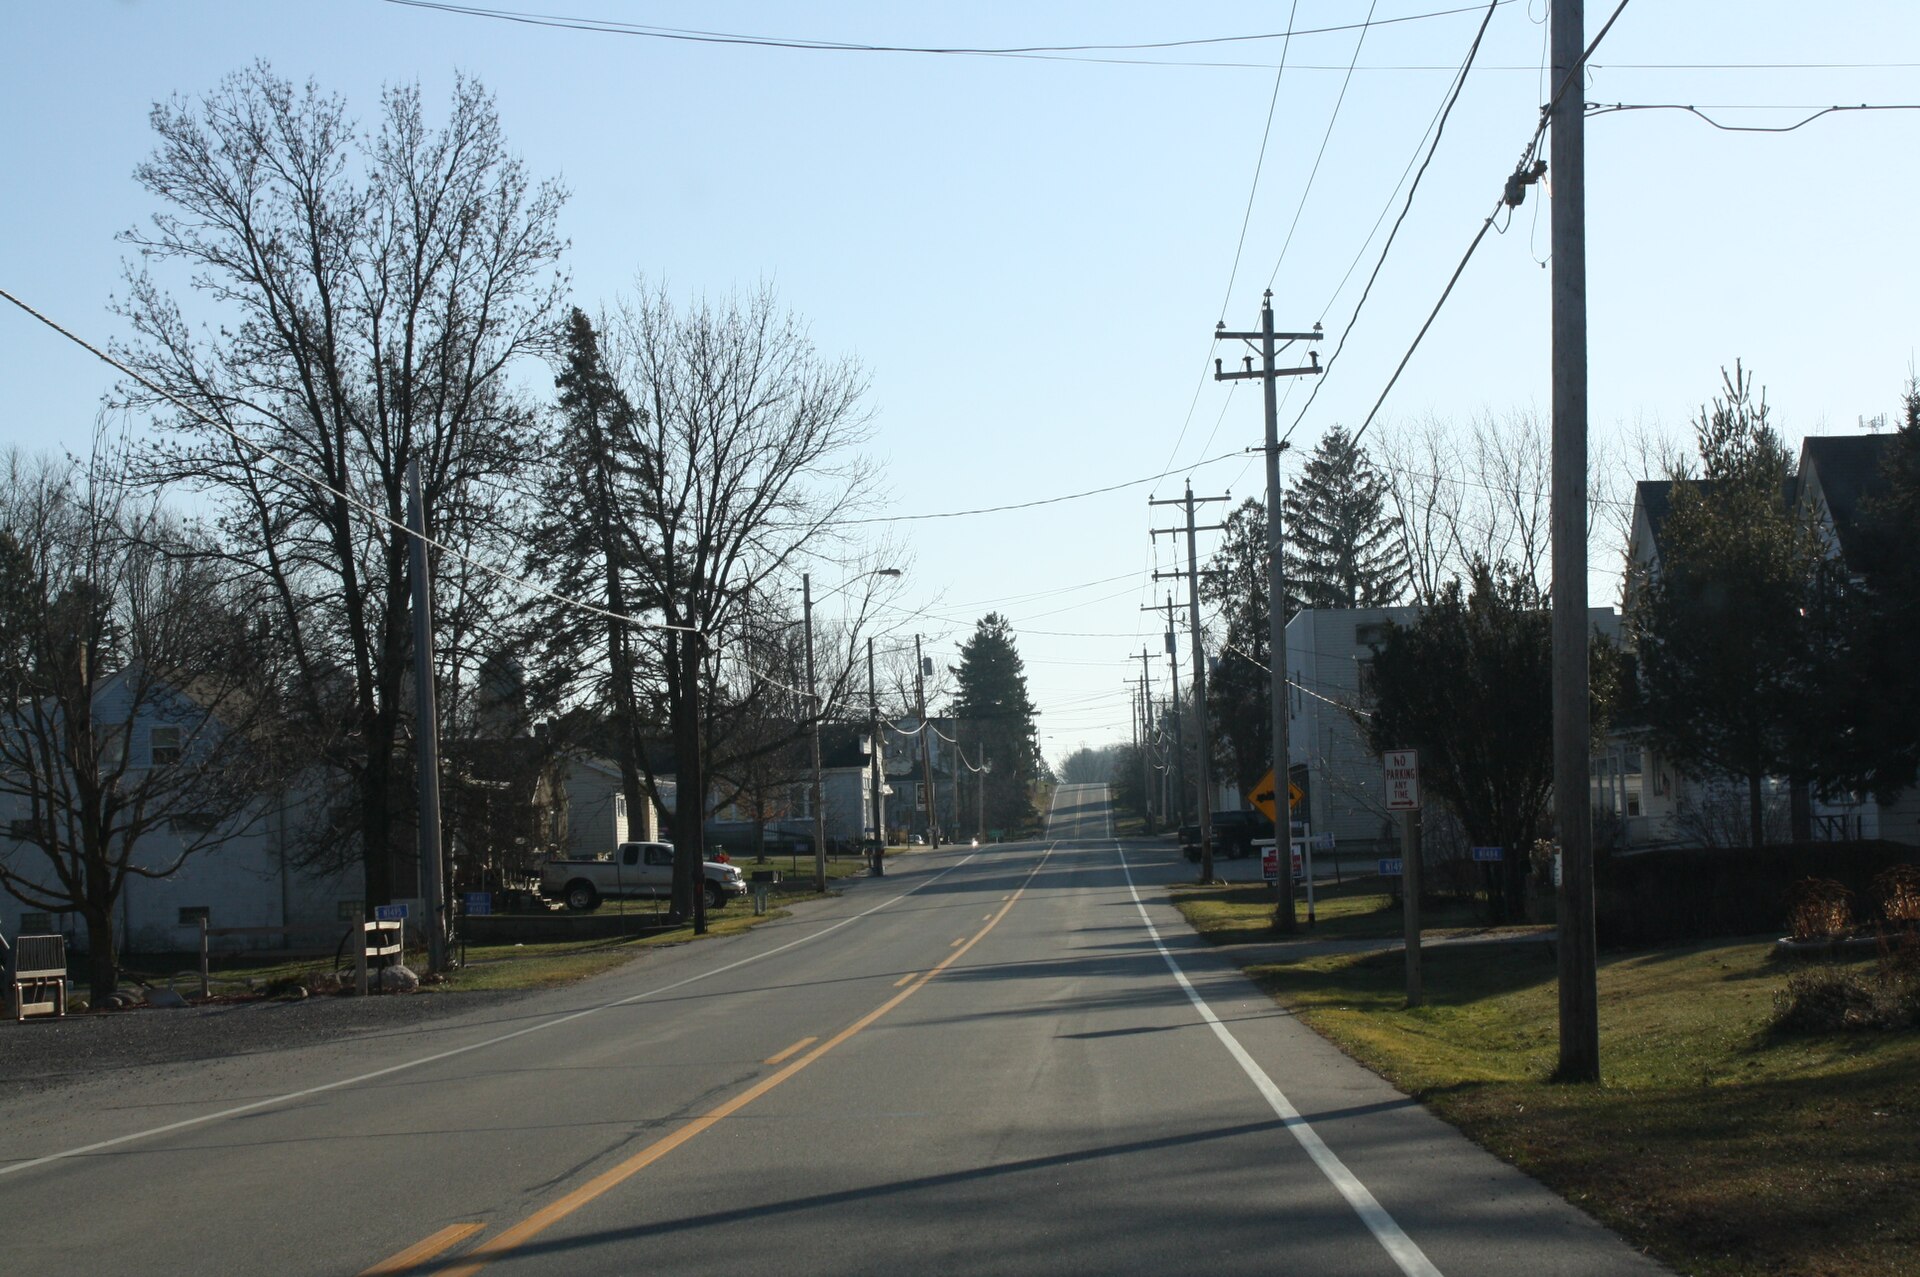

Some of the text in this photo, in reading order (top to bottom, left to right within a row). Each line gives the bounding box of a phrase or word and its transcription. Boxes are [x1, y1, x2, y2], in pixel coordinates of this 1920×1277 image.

[1394, 755, 1406, 767] NO
[1386, 768, 1415, 780] PARKING
[1394, 781, 1407, 789] ANY
[1394, 790, 1409, 799] TIME
